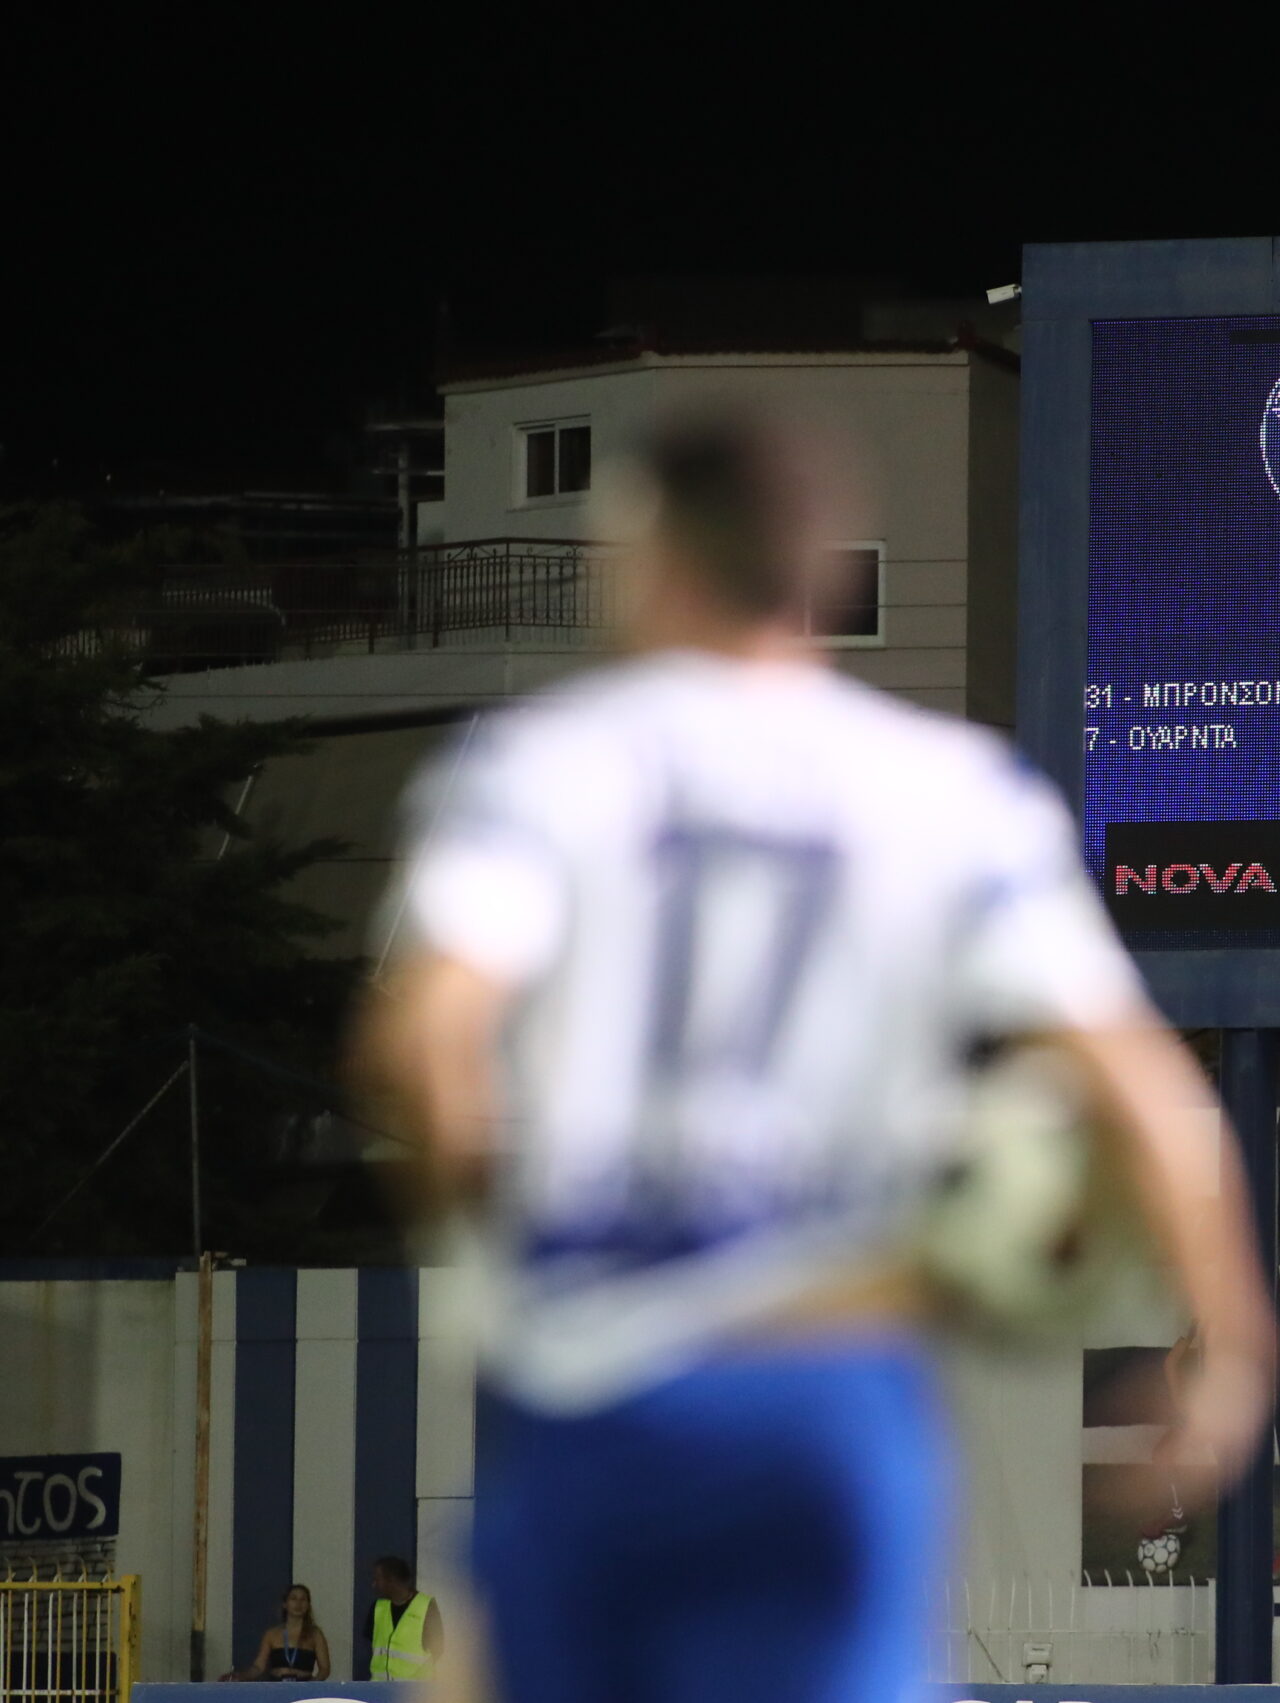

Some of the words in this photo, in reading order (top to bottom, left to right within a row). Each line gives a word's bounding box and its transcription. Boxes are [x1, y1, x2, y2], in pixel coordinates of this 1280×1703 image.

[1085, 684, 1112, 708] 31
[1085, 727, 1100, 751] 7
[1129, 724, 1237, 750] ΟΥΑΡΝΤΑ
[1115, 864, 1277, 894] NOVA
